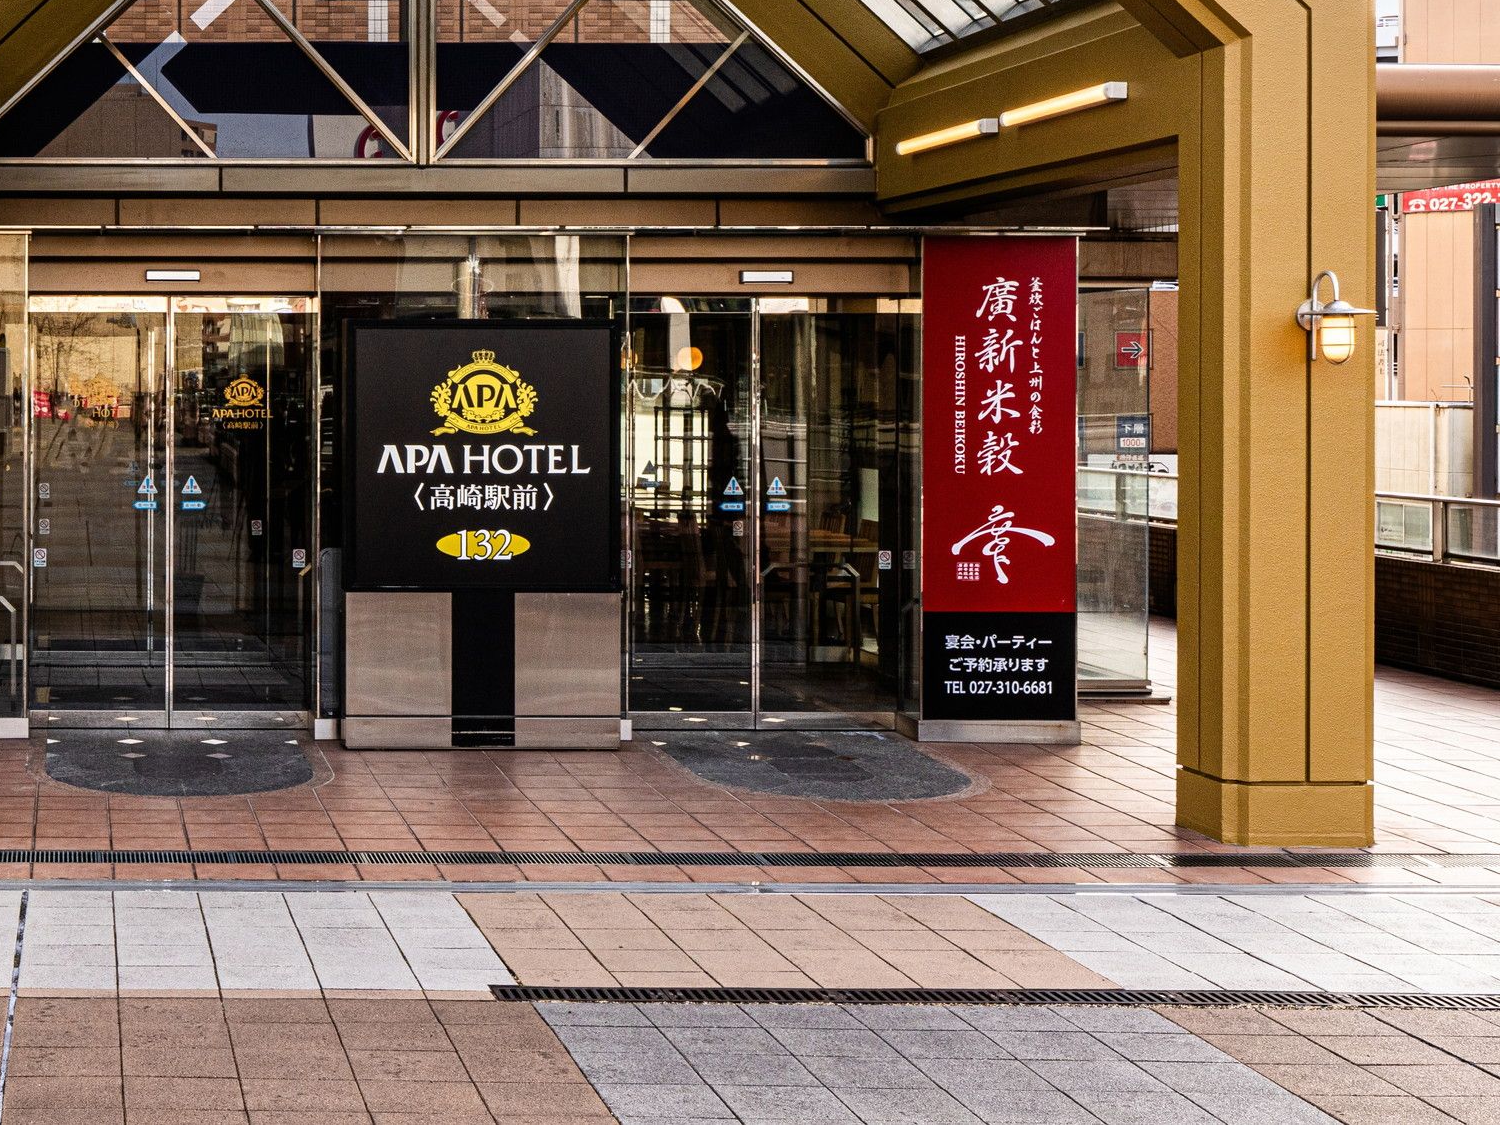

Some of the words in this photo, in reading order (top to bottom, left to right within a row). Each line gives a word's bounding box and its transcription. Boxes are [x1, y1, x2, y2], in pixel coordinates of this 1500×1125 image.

[1429, 192, 1500, 210] 027-322-
[954, 335, 966, 406] HIROSHIN
[974, 276, 1024, 476] 廣新米穀
[451, 383, 517, 409] APA
[212, 408, 234, 418] APA
[236, 408, 273, 418] HOTEL
[954, 410, 966, 474] BEIKOKU
[376, 444, 454, 474] APA
[462, 444, 591, 475] HOTEL
[456, 529, 513, 561] 132
[945, 633, 1053, 650] 宴会・パーティー
[949, 656, 1049, 673] ご予約承ります
[944, 680, 966, 694] TEL
[969, 680, 1053, 695] 027-310-6681
